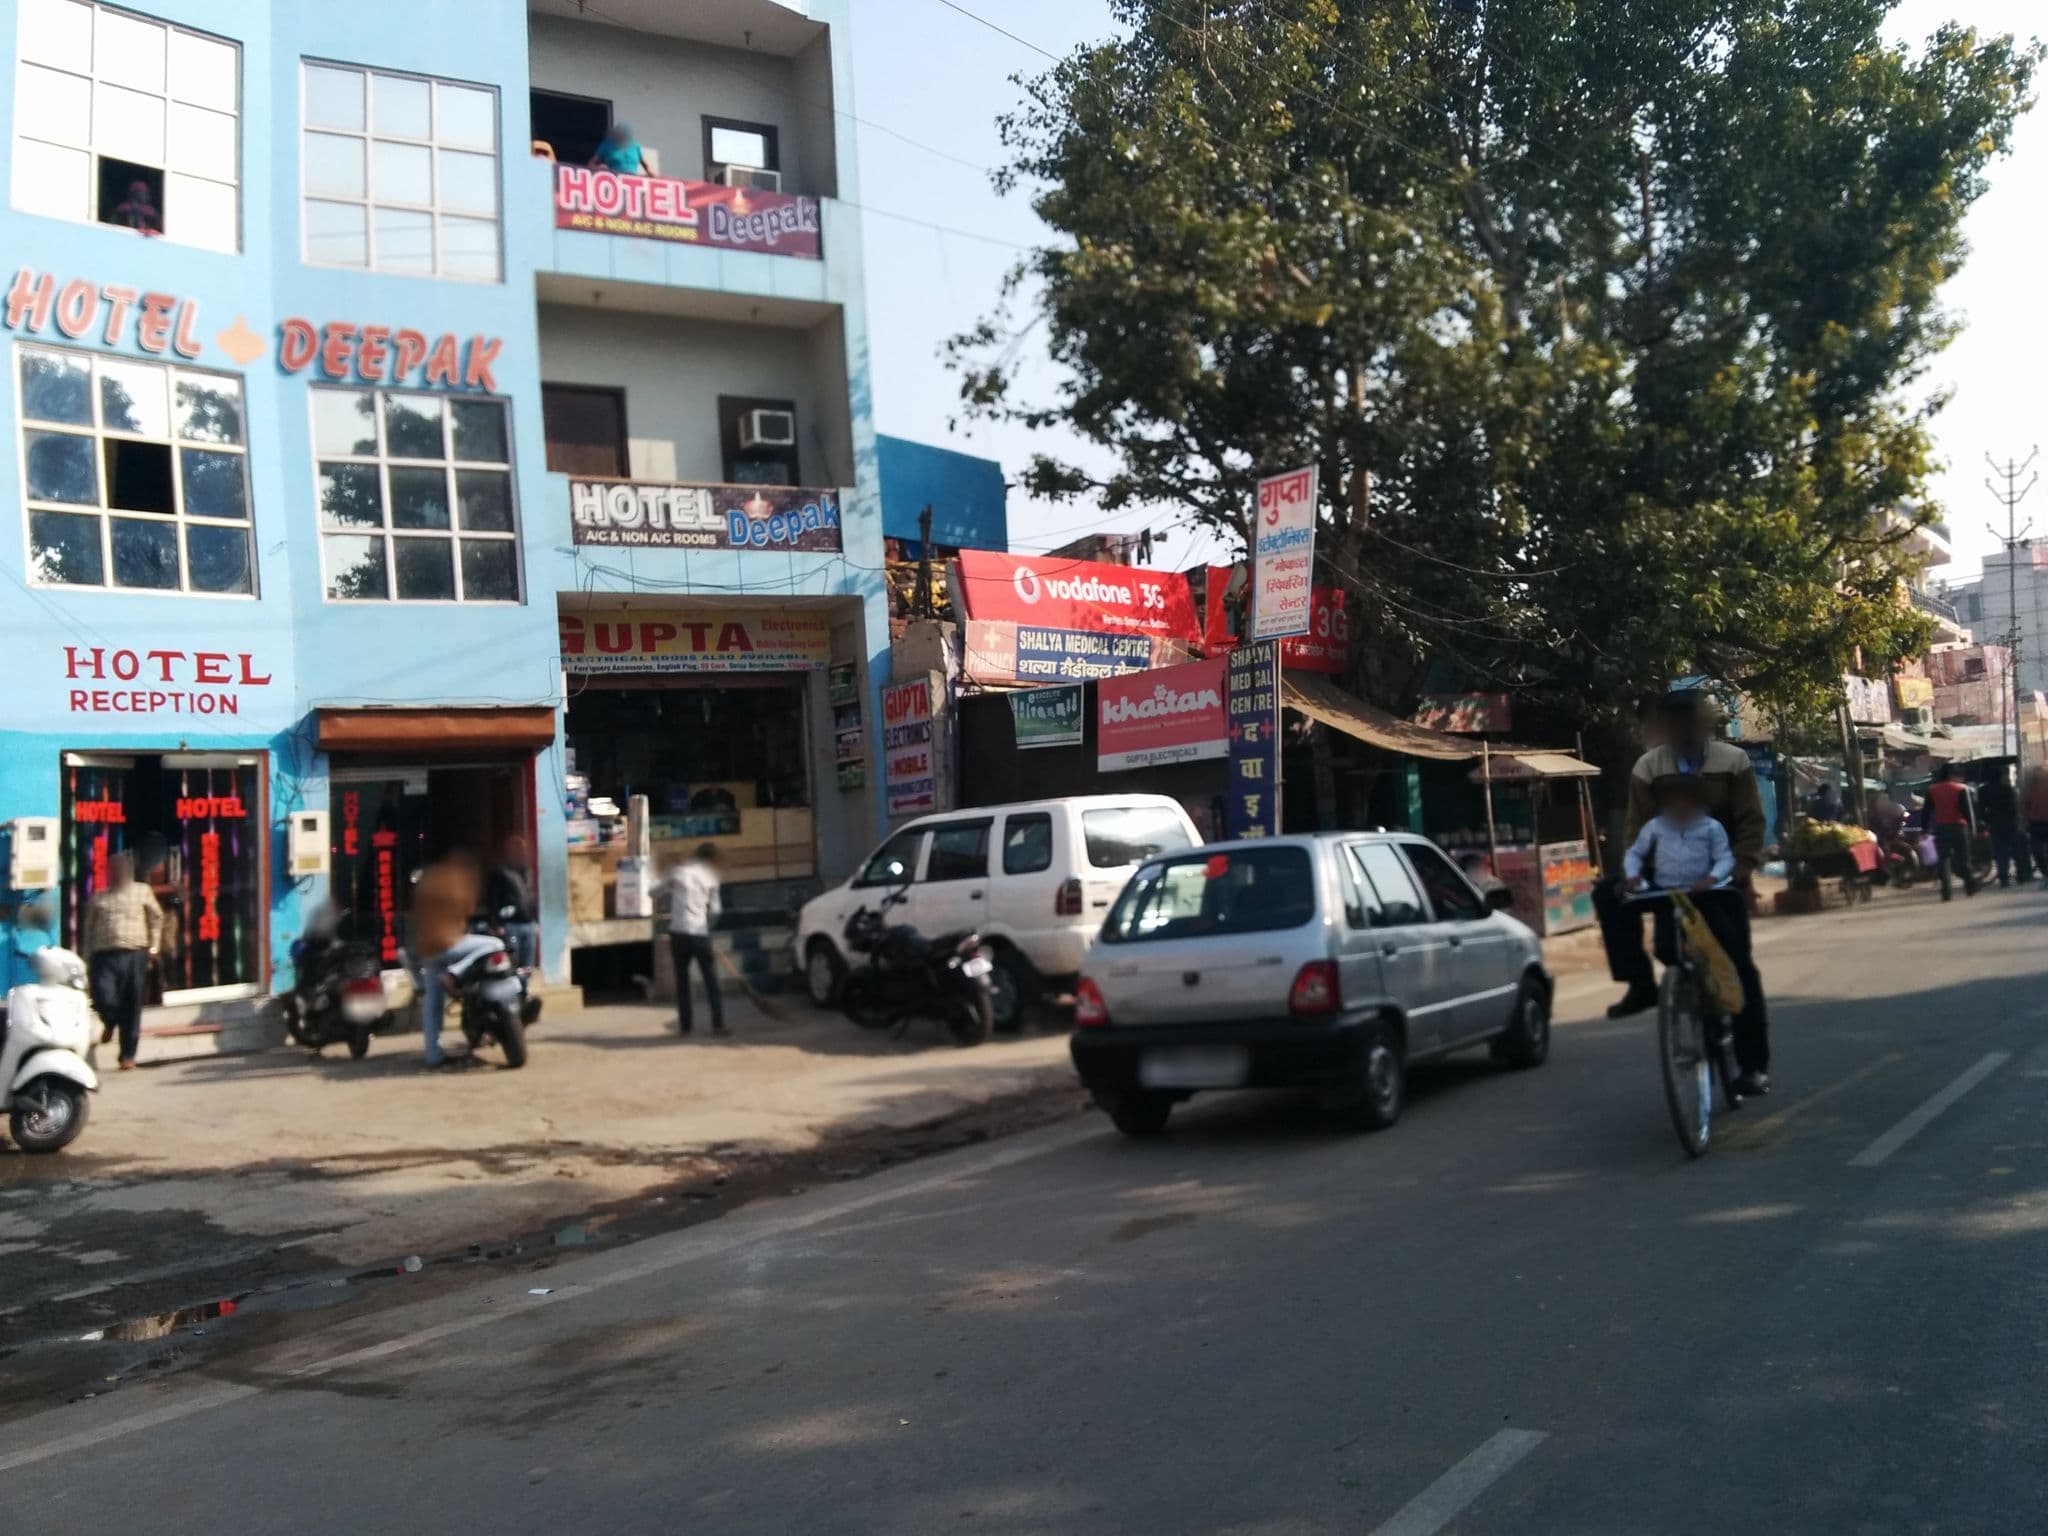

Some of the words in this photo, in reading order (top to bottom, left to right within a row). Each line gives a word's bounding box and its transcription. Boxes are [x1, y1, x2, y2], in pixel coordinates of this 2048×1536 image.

[559, 166, 698, 224] HOTEL
[708, 196, 819, 245] Deepak
[4, 267, 202, 358] HOTEL
[277, 317, 503, 392] DEEPAK
[572, 483, 727, 531] HOTEL
[727, 494, 840, 546] Deepak
[1259, 472, 1310, 526] गुप्ता
[621, 532, 648, 543] NON
[674, 534, 716, 545] ROOMS
[1044, 576, 1131, 604] vodafone
[1140, 583, 1165, 609] 3G
[559, 615, 754, 653] GUPTA
[1317, 605, 1348, 640] 3G
[1020, 630, 1062, 651] SHALYA
[1066, 634, 1110, 656] MEDICAL
[1113, 637, 1150, 659] CENTRE
[1231, 645, 1271, 668] SHALYA
[64, 646, 272, 686] HOTEL
[1230, 670, 1272, 692] MEDCAL
[70, 690, 238, 714] RECEPTION
[885, 683, 928, 723] GUPTA
[1102, 684, 1221, 724] khaitan
[75, 802, 126, 824] HOTEL
[176, 797, 247, 819] HOTEL
